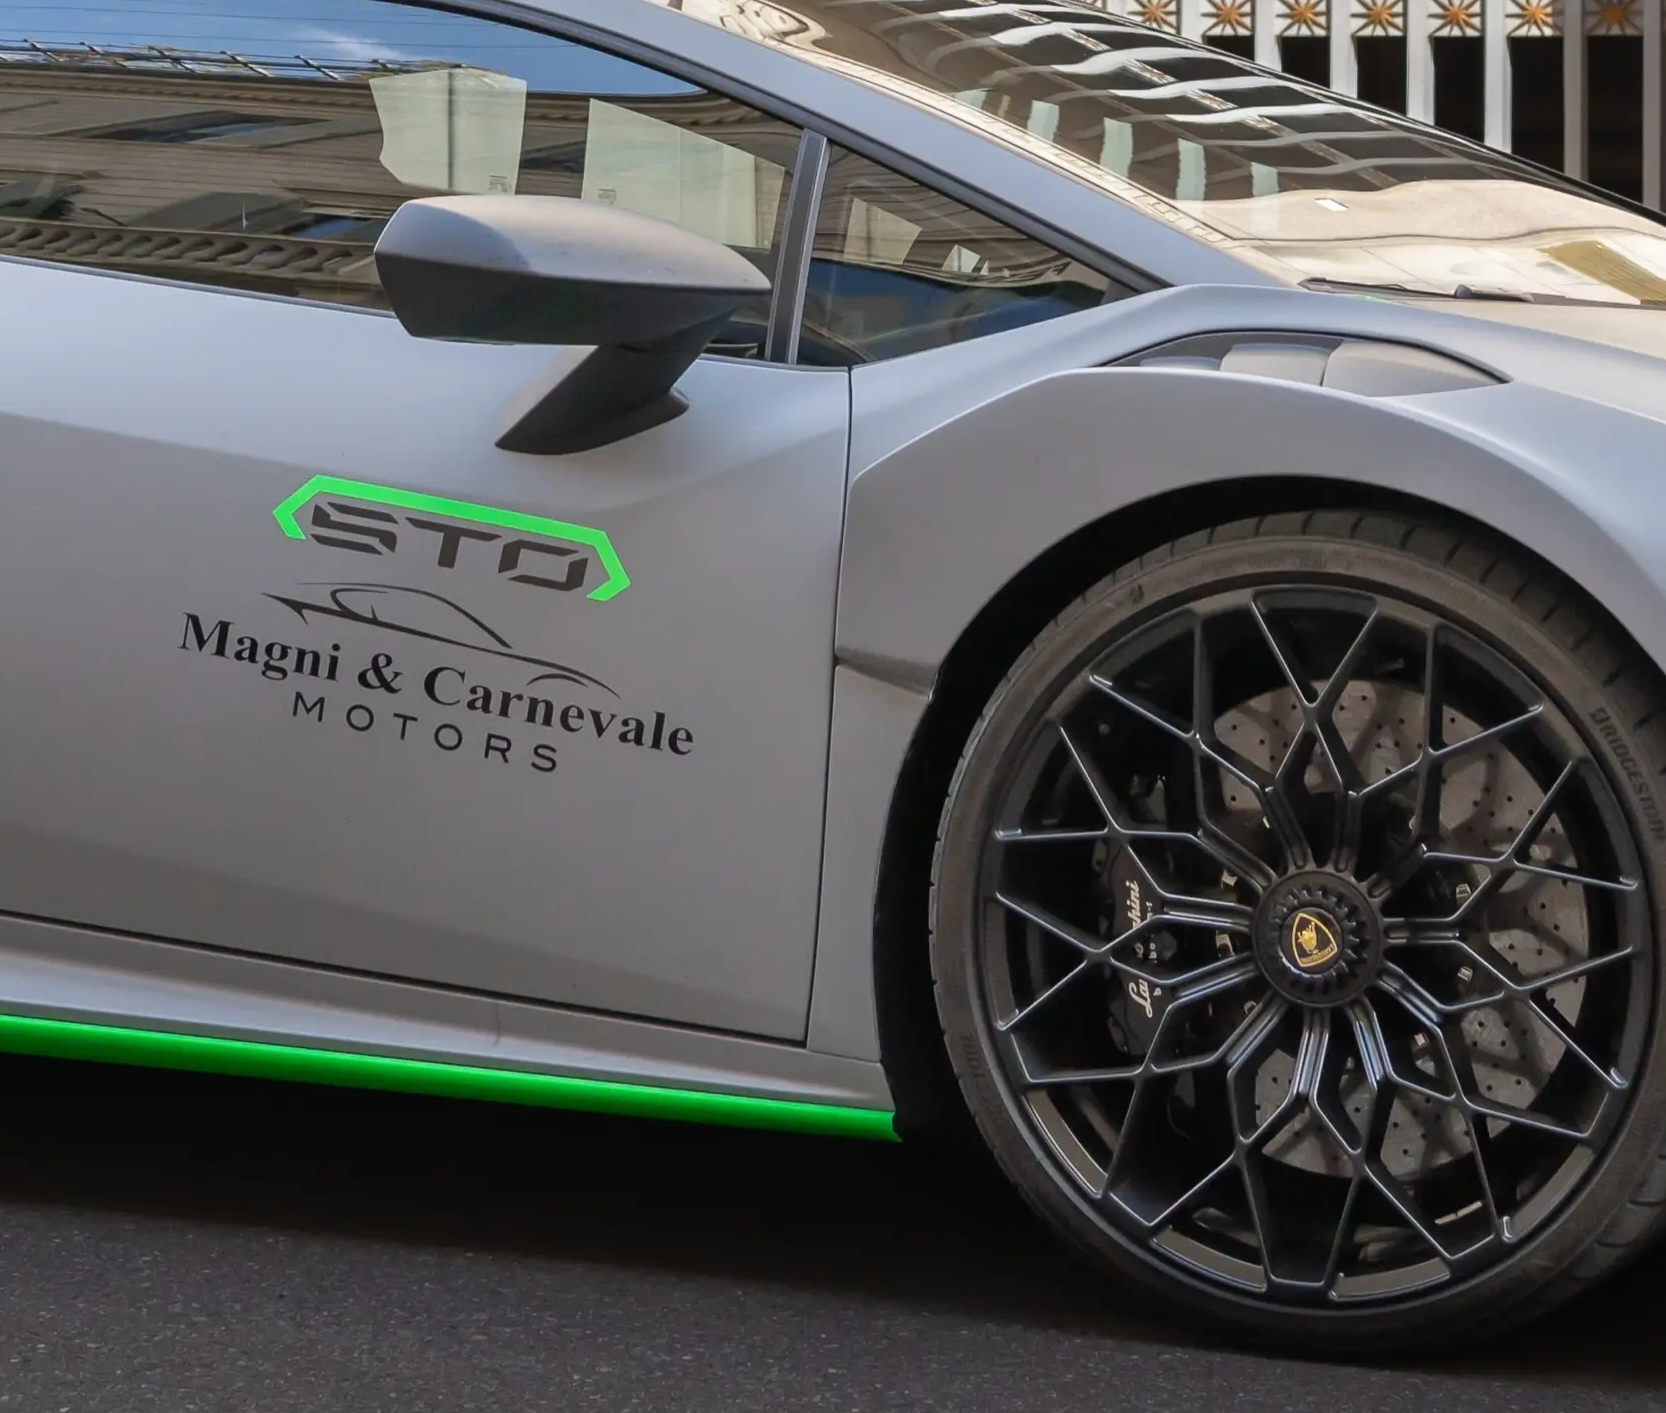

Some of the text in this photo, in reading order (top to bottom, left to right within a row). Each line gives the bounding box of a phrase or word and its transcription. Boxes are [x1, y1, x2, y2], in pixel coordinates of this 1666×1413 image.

[309, 500, 590, 592] STO
[177, 612, 696, 756] Magni & Carnevale
[292, 691, 559, 774] MOTORS
